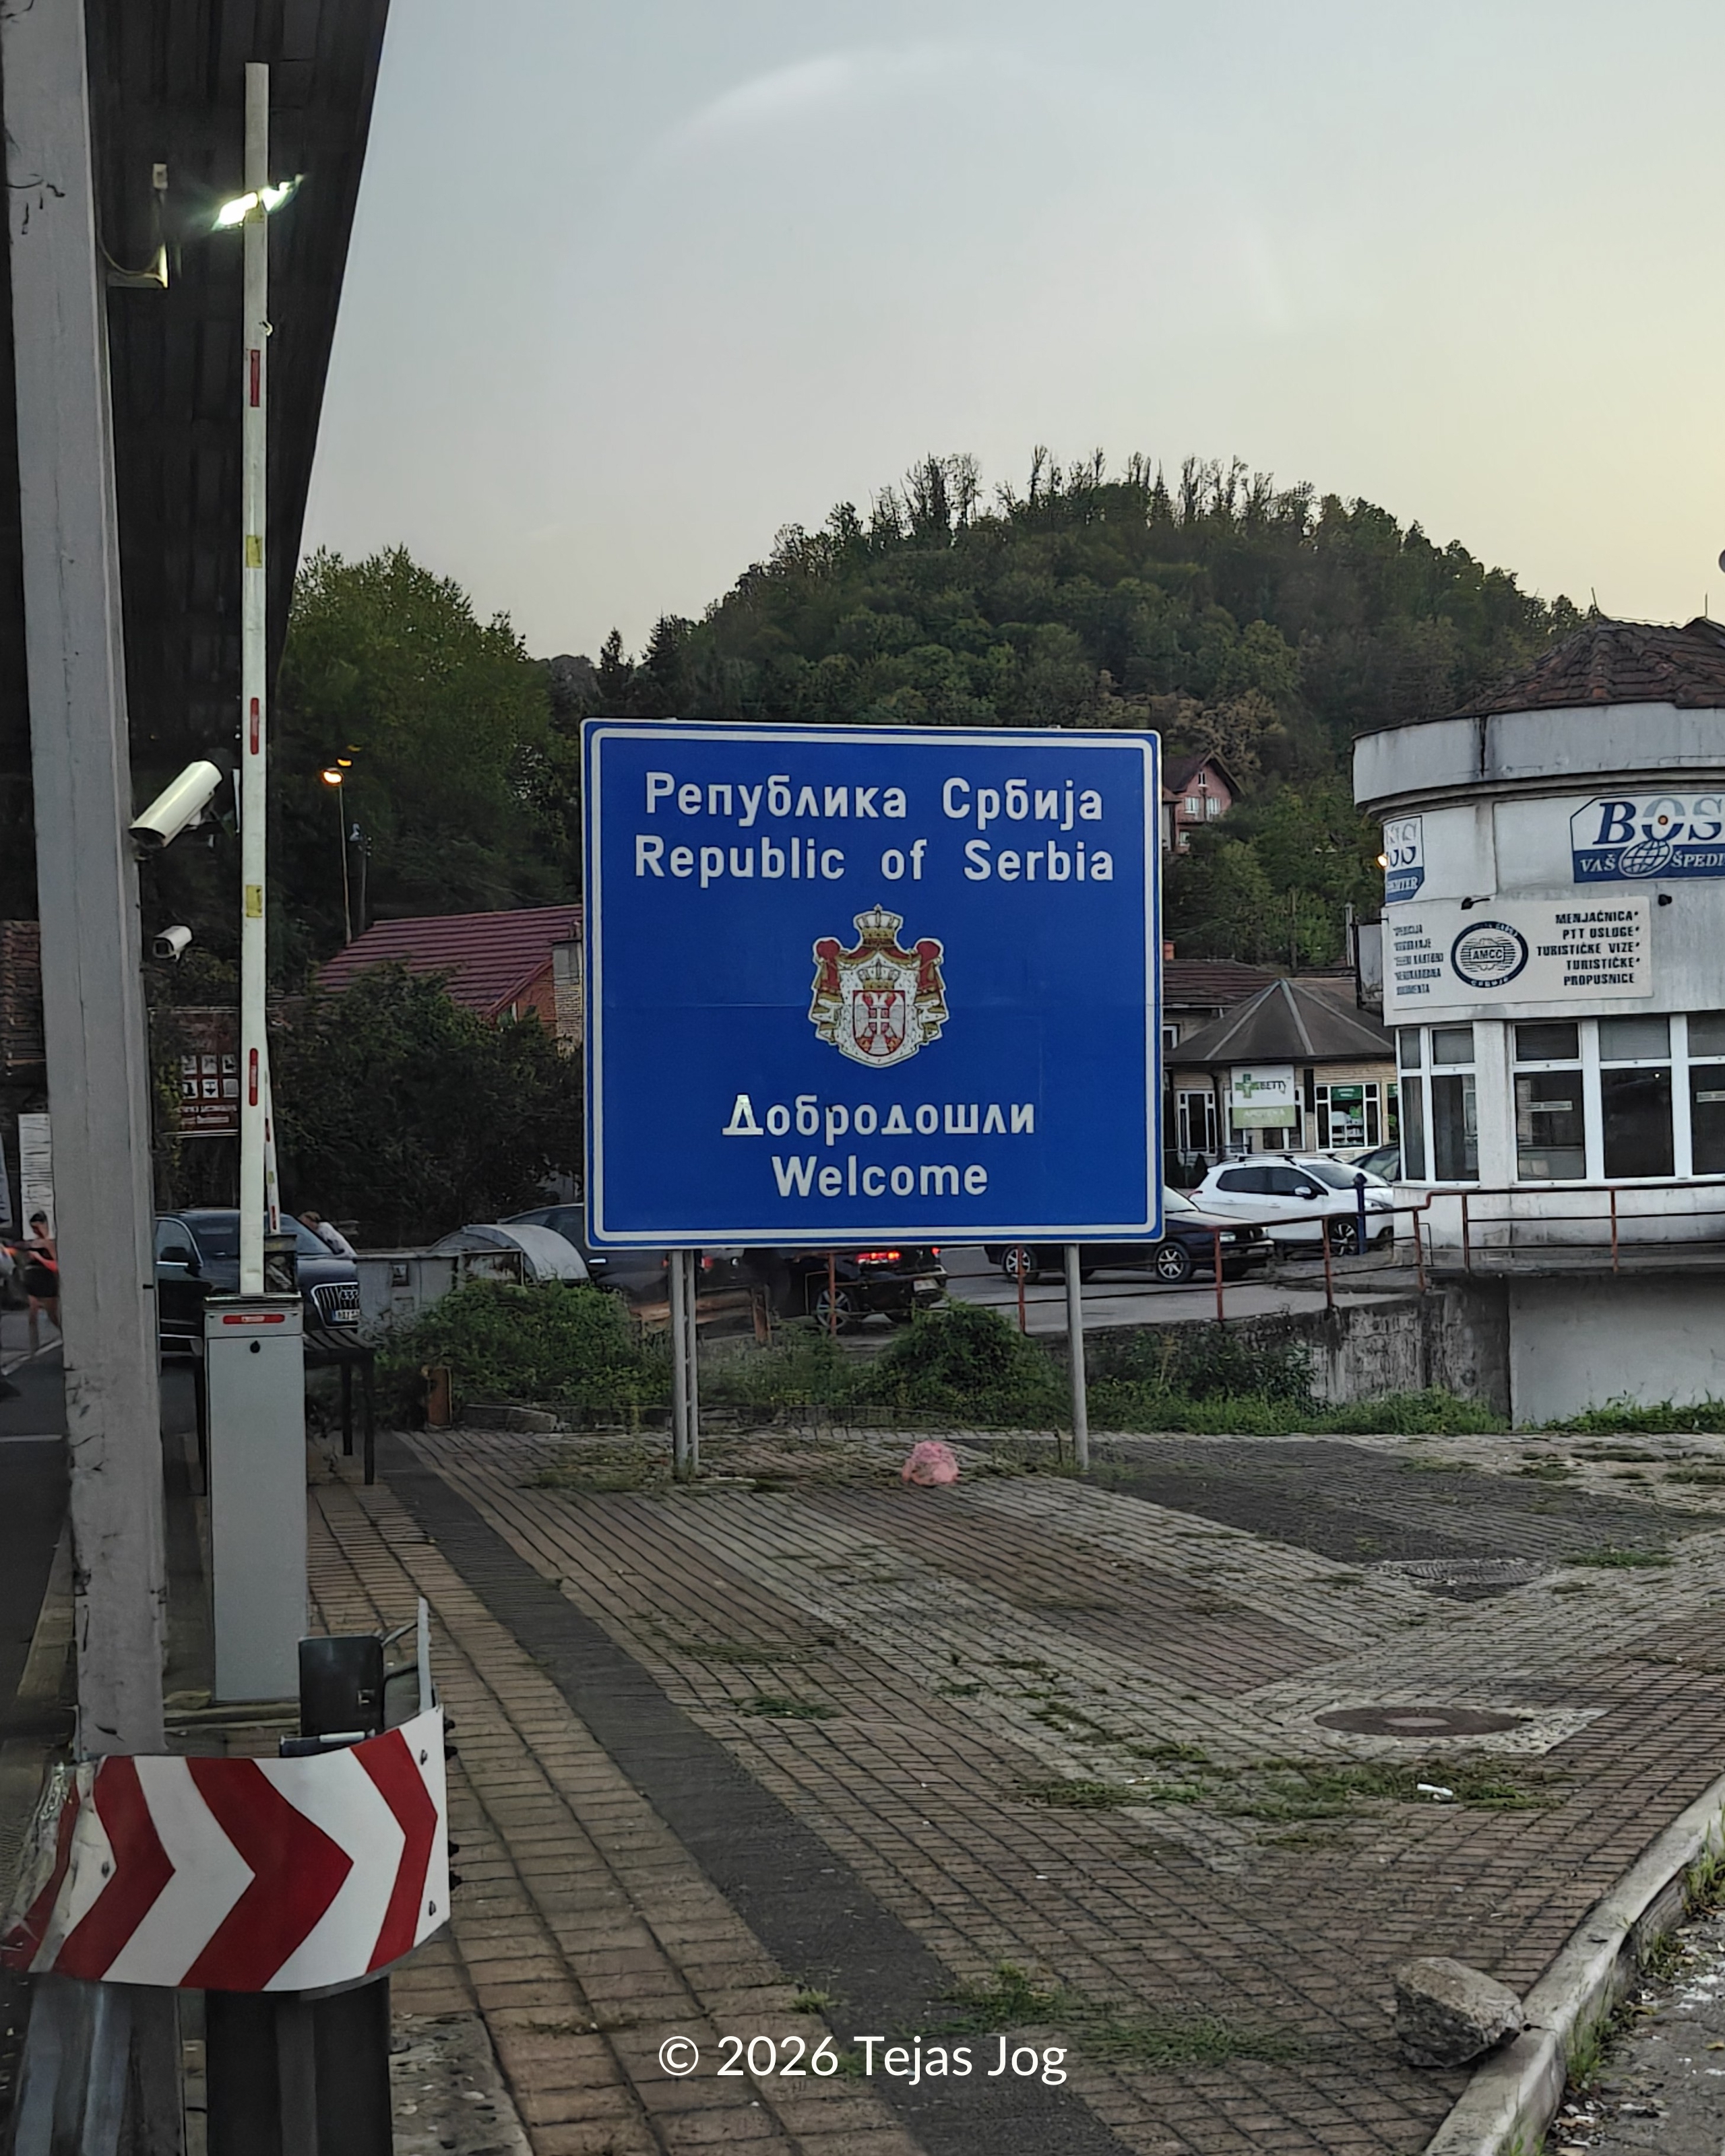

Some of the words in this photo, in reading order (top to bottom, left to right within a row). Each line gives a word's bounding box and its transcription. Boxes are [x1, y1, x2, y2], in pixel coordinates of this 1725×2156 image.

[646, 771, 907, 827] Република
[942, 777, 1103, 831] Србија
[635, 834, 845, 889] Republic
[880, 838, 927, 880] of
[964, 839, 1114, 881] Serbia
[1580, 854, 1616, 872] VAŠ
[1670, 850, 1725, 868] ŠPEDI
[1563, 928, 1585, 940] PTT
[1590, 926, 1633, 938] USLUGE
[1536, 942, 1601, 956] TURISTIČKE
[1608, 942, 1634, 953] VIZE
[1567, 957, 1635, 970] TURISTIČKE
[1563, 973, 1635, 986] PROPUSNICE
[722, 1094, 1035, 1146] Добродошли
[771, 1155, 989, 1197] Welcome
